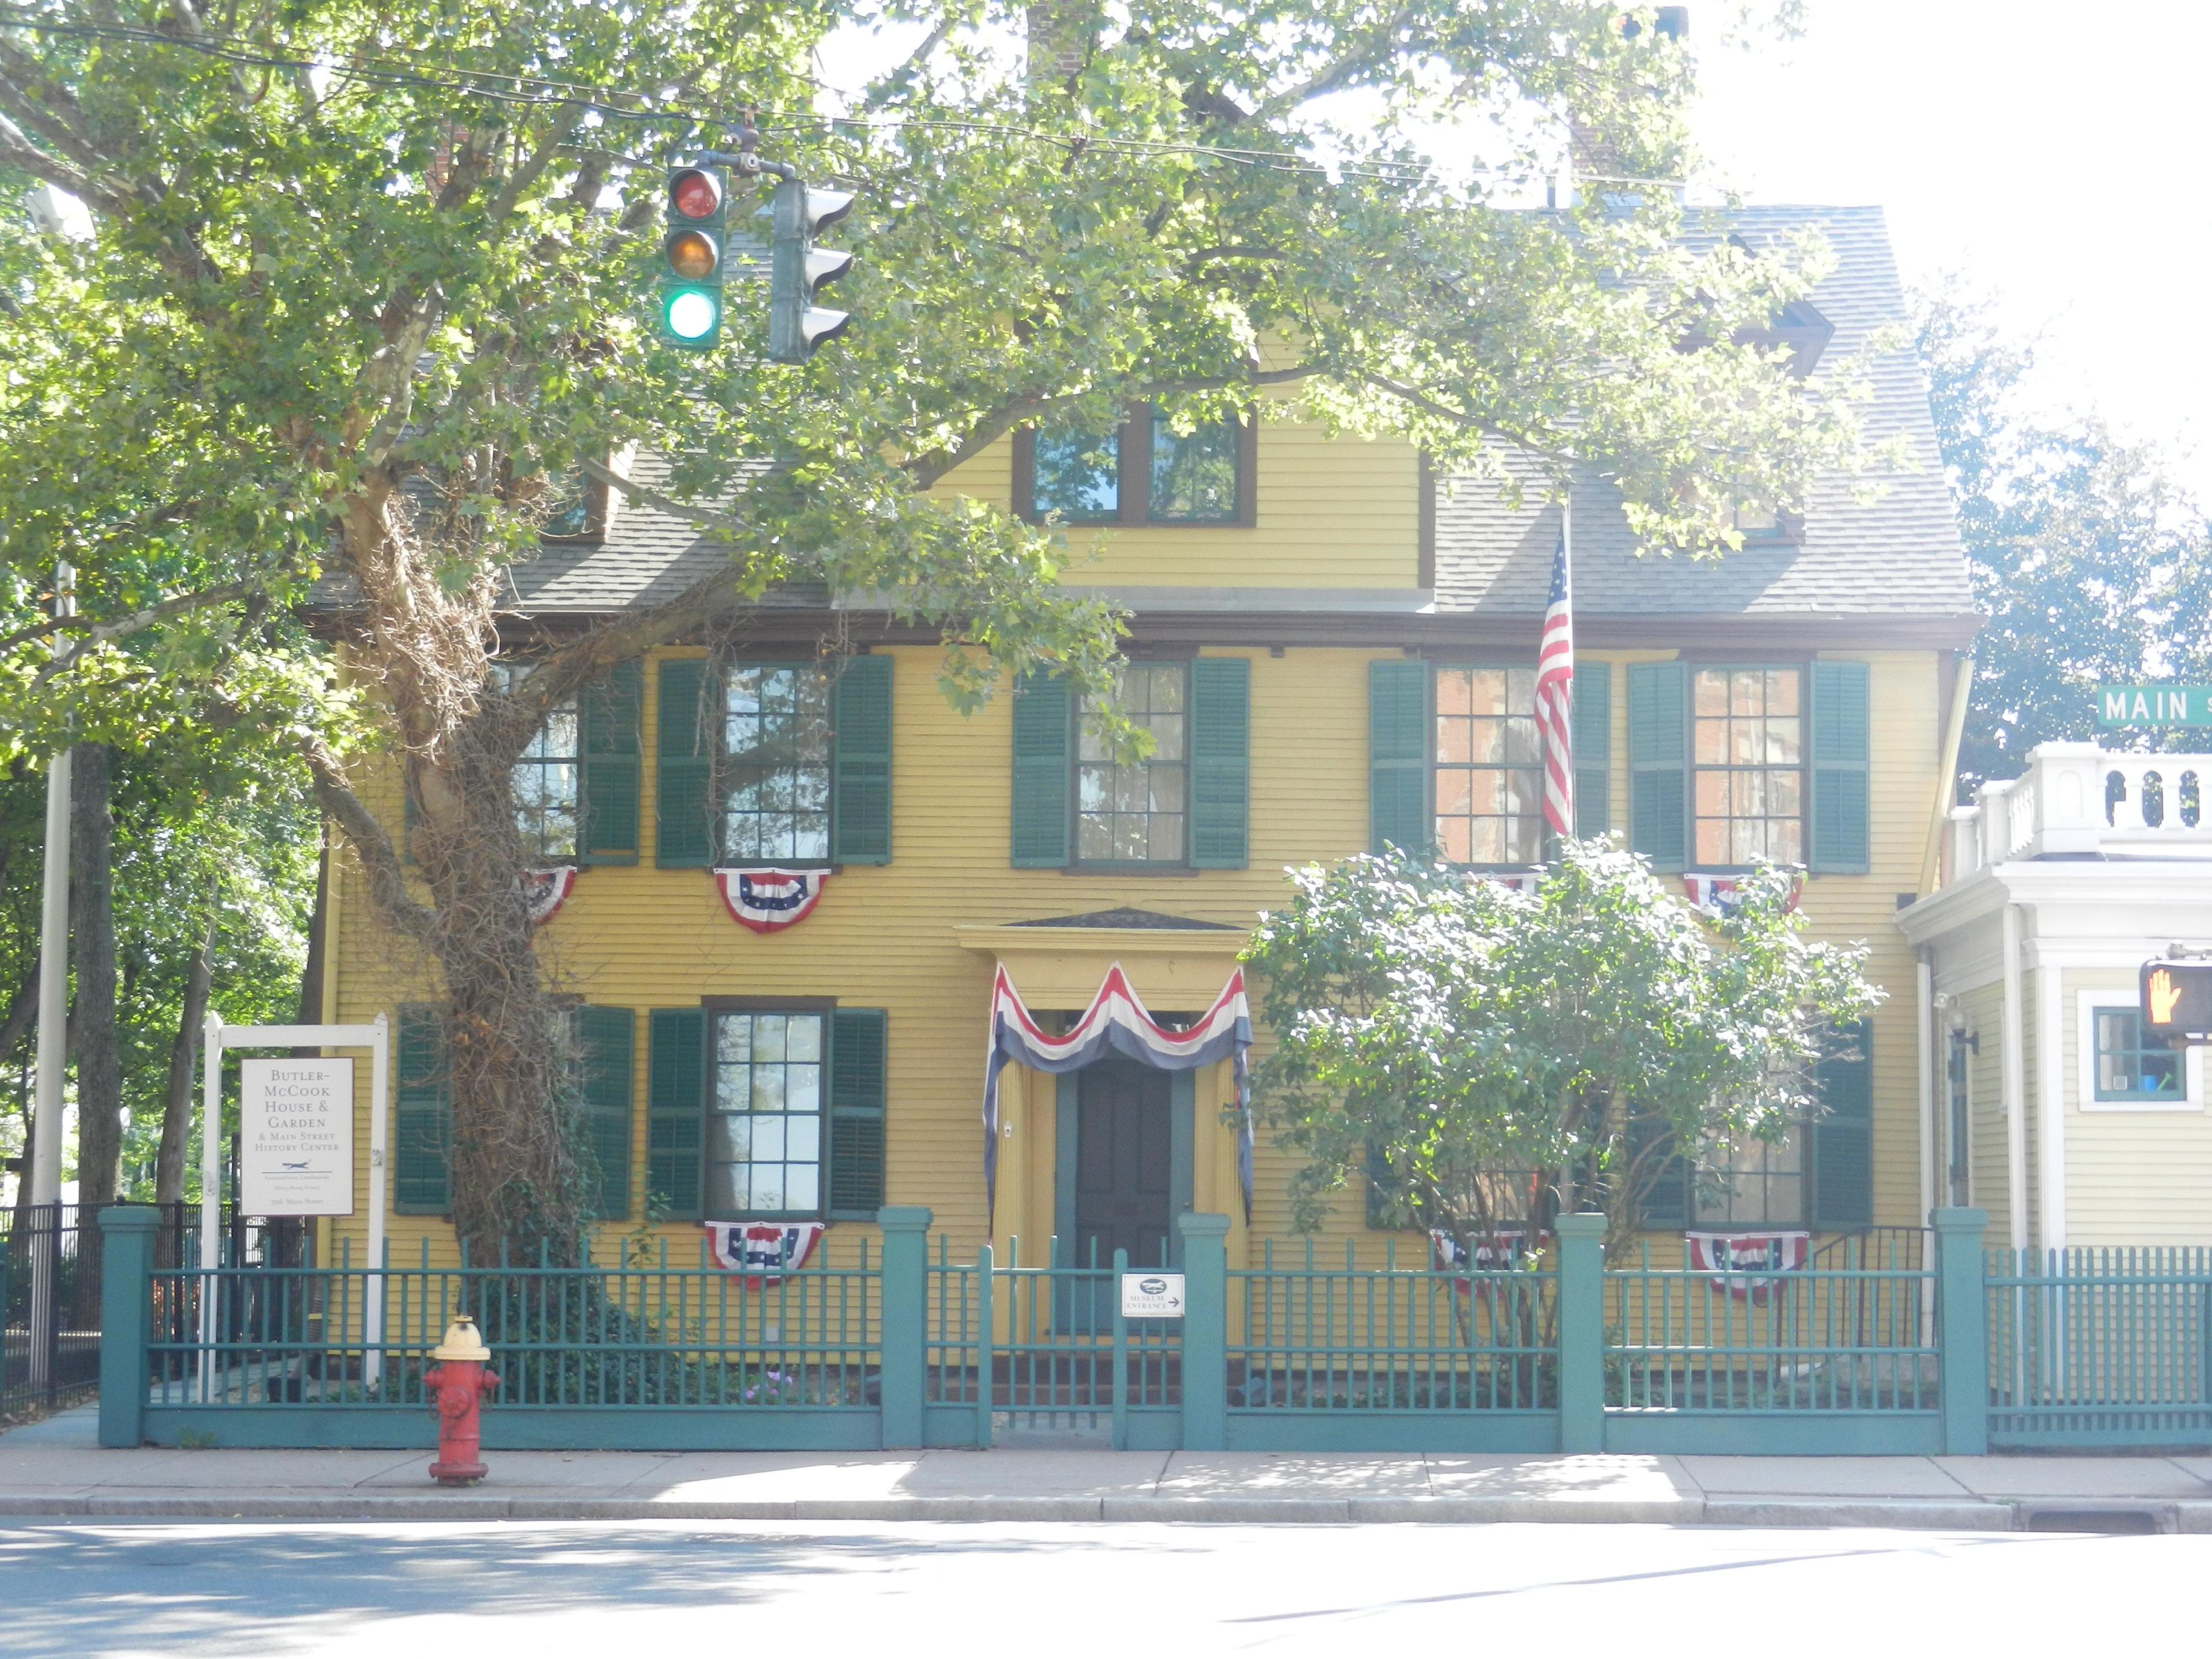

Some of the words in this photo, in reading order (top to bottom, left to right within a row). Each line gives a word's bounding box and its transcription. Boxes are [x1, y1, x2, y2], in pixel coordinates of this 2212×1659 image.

[2106, 692, 2187, 719] MAIN
[272, 1070, 330, 1081] BUTLER-
[266, 1101, 313, 1112] HOUSE
[319, 1101, 328, 1112] &
[268, 1117, 325, 1128] GARDEN
[271, 1132, 297, 1141] MAIN
[301, 1132, 335, 1140] STREET
[255, 1143, 297, 1152] HISTORY
[301, 1143, 339, 1152] CENTER
